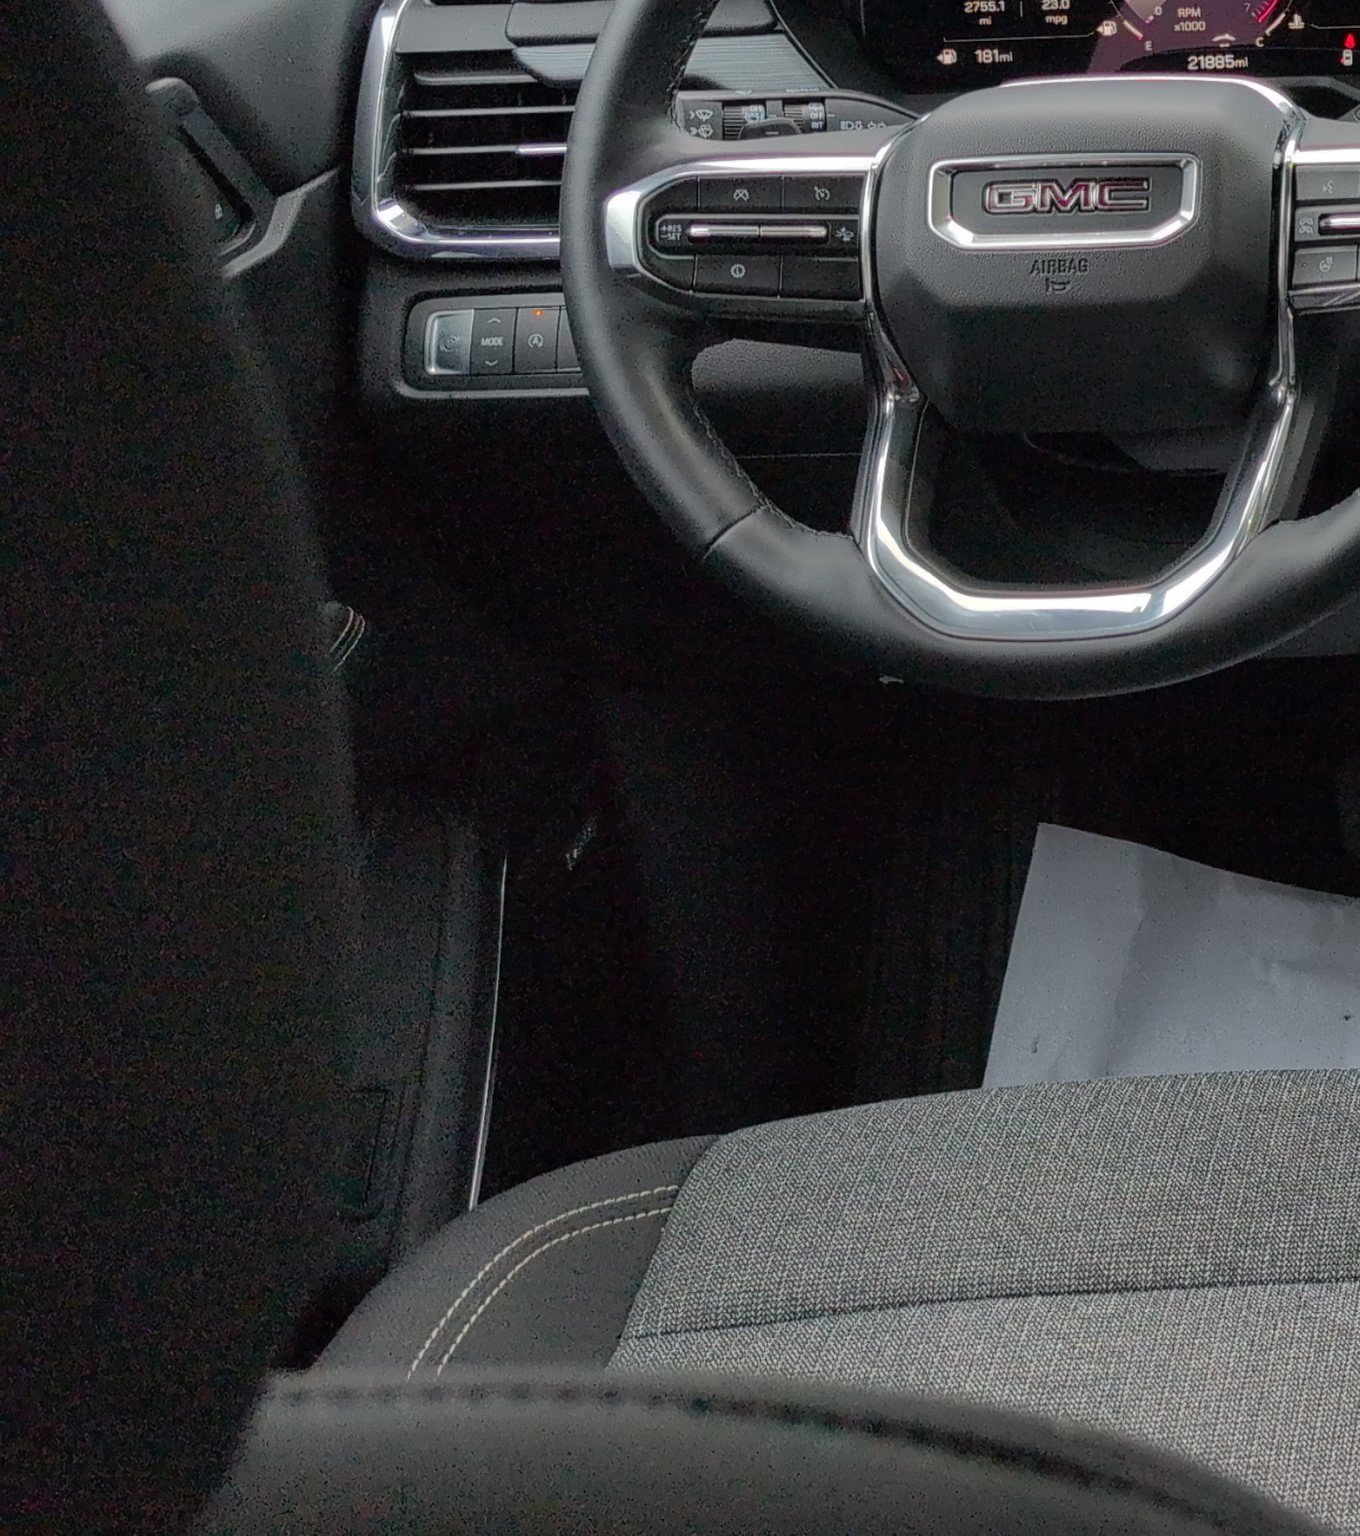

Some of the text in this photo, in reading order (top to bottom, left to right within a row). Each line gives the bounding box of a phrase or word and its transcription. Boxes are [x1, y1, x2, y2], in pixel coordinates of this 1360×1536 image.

[964, 0, 1005, 14] 2755.1
[1177, 6, 1202, 18] RPM
[978, 15, 992, 26] mi
[1044, 14, 1068, 26] mpg
[1173, 20, 1207, 32] x1000
[1255, 37, 1263, 47] C
[984, 178, 1150, 215] GMC
[1031, 258, 1088, 275] AIRBAG
[481, 337, 503, 346] MODE
